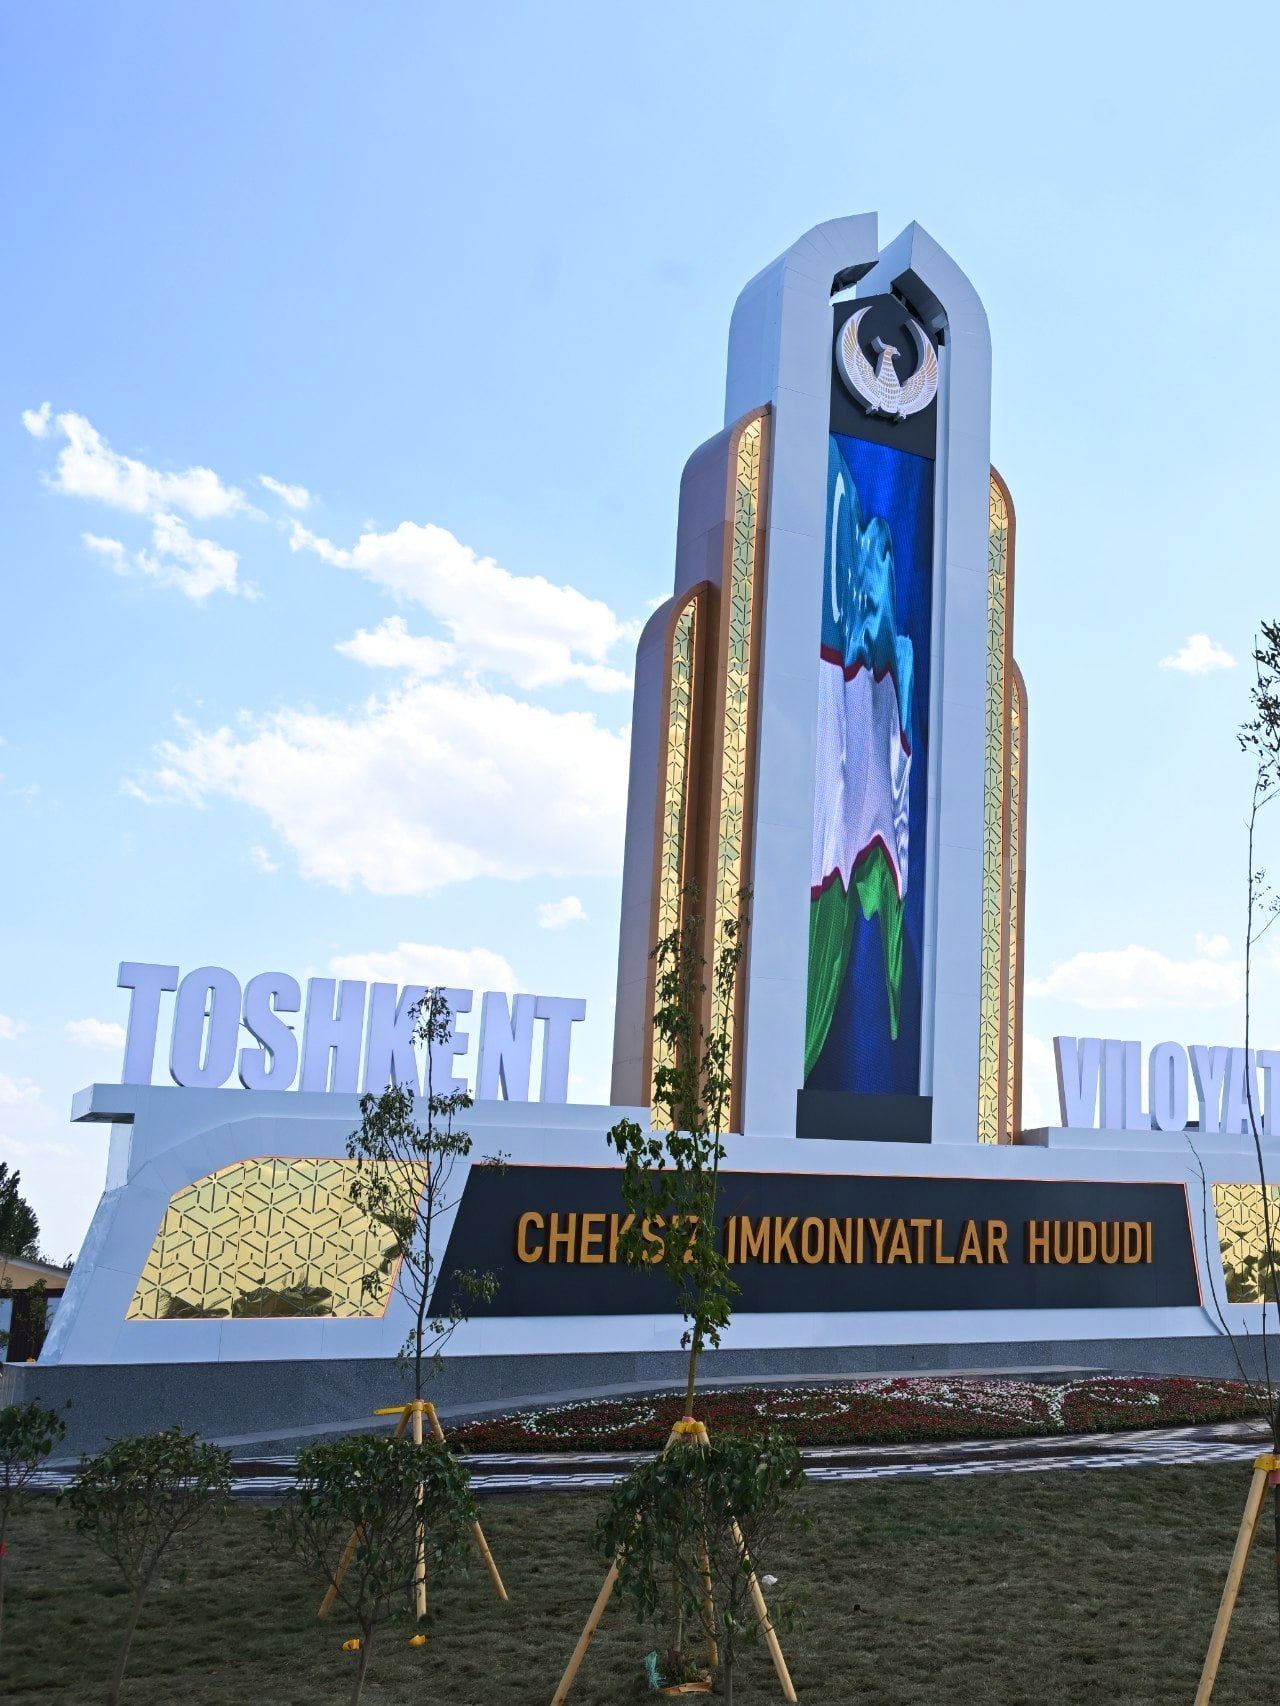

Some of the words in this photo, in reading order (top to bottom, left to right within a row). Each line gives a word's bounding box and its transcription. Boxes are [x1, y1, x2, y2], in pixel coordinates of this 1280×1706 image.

[117, 961, 586, 1104] TOSHKENT
[515, 1210, 701, 1264] CHEKSZ
[725, 1213, 1008, 1265] IMKONIYATLAR
[1026, 1218, 1153, 1265] HUDUDI
